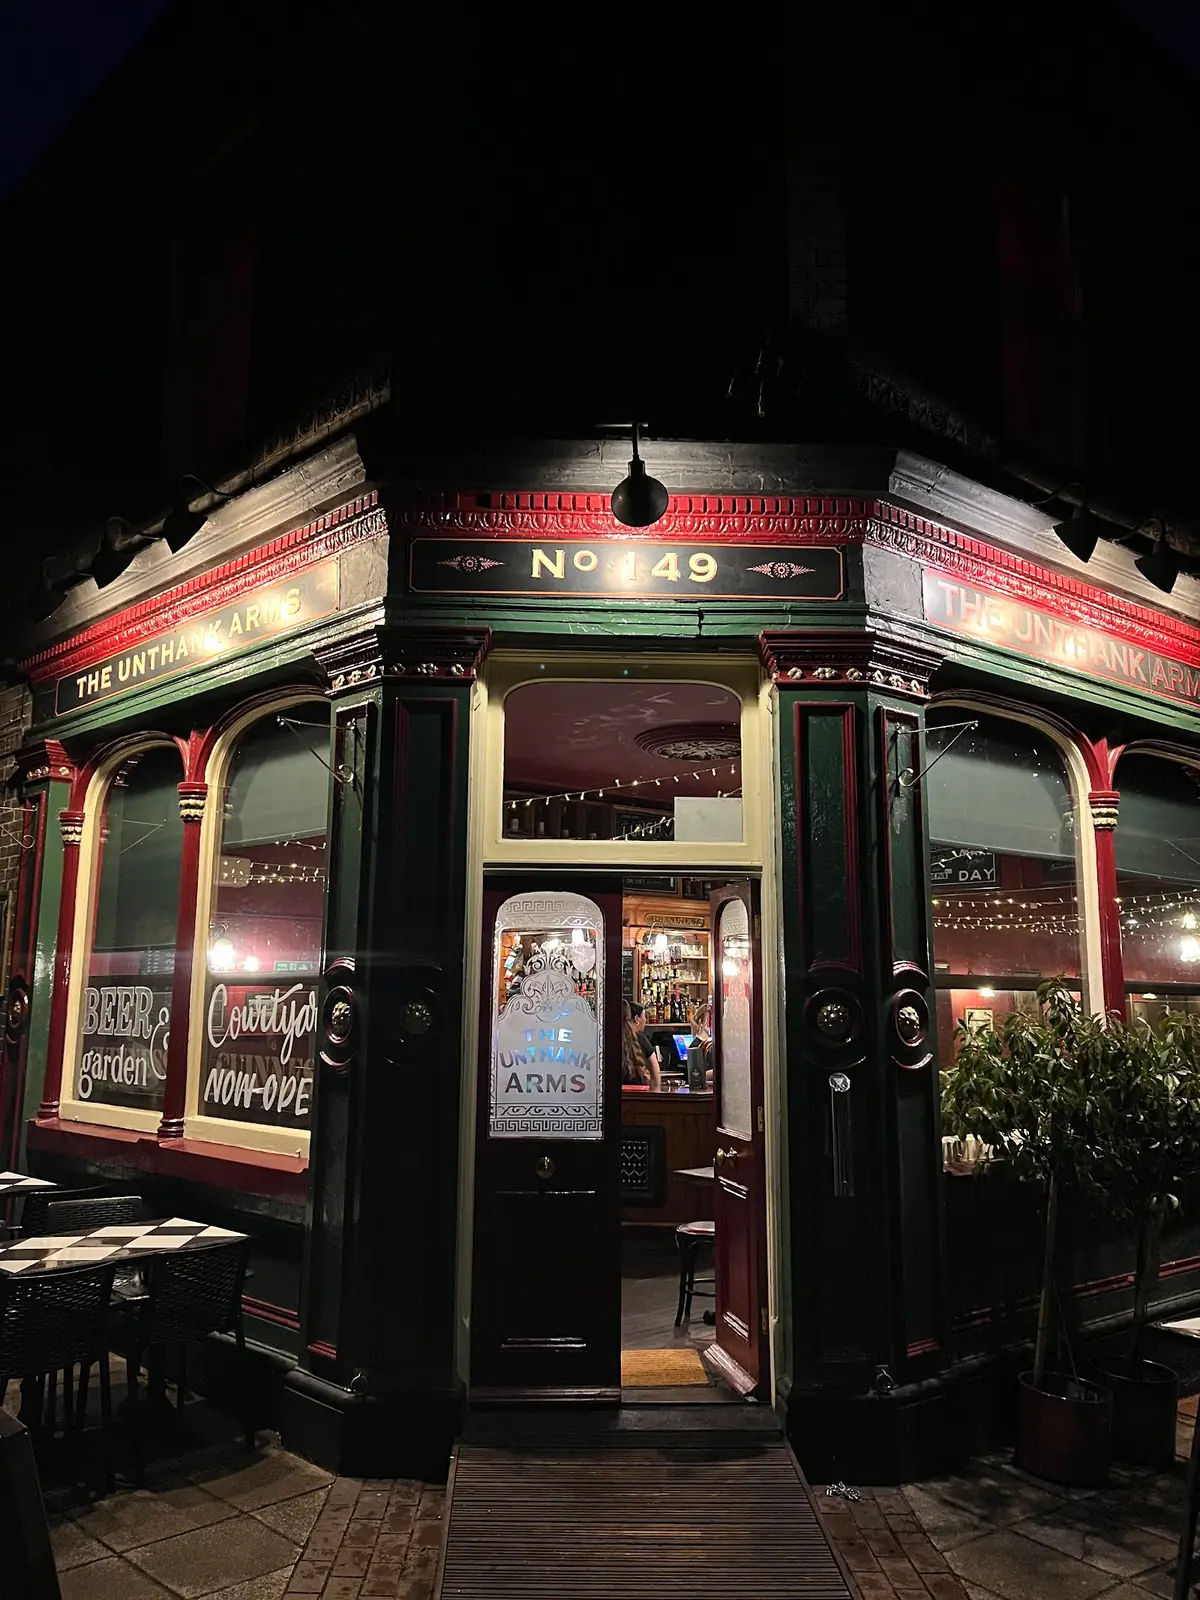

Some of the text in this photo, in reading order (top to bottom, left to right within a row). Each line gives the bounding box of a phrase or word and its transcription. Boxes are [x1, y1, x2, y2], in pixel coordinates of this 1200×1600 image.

[625, 551, 718, 583] 149
[76, 588, 302, 698] THE UNTHANK ARMS
[937, 579, 1004, 630] THE
[1014, 611, 1148, 683] UNTHANK
[958, 867, 994, 882] DAY
[81, 986, 153, 1039] BEER
[207, 983, 318, 1065] Courtyar
[522, 1027, 573, 1043] THE
[78, 1043, 147, 1098] garden
[499, 1045, 595, 1071] UNTHANK
[505, 1072, 586, 1093] ARMS
